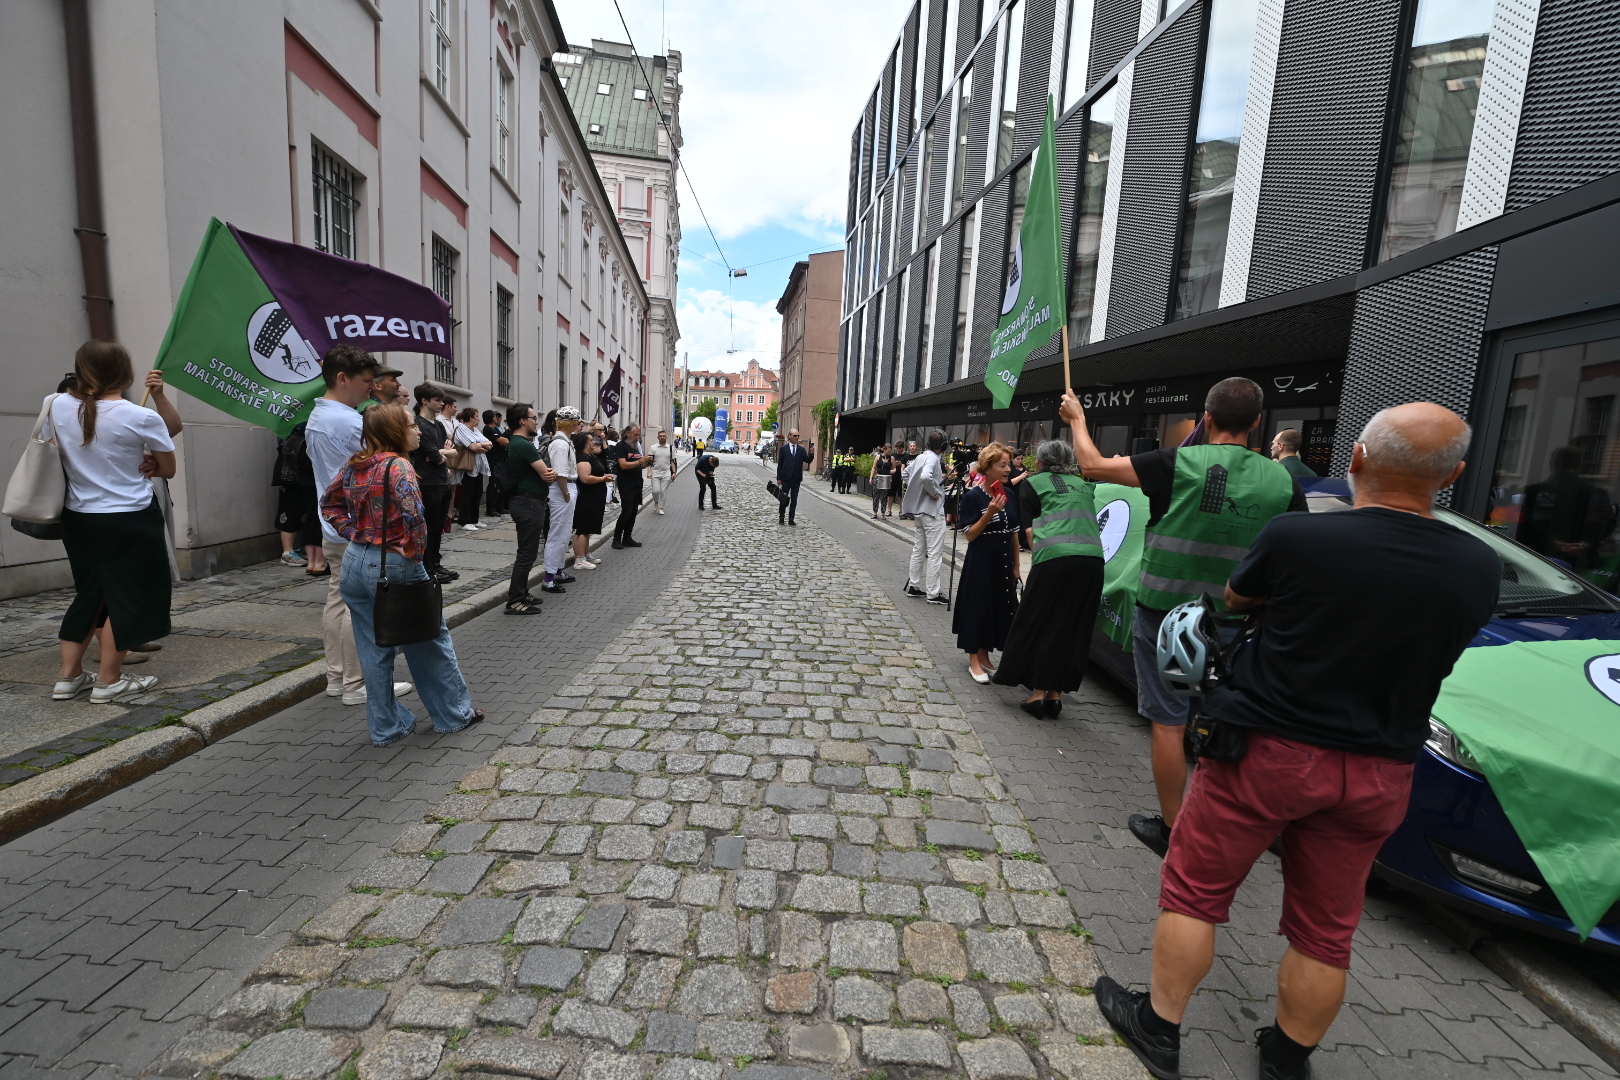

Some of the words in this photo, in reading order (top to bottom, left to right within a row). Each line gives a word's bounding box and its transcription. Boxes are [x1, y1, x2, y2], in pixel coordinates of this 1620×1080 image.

[324, 314, 446, 344] razem
[183, 361, 264, 409] MALTAŃSKIE
[1145, 385, 1167, 394] asian
[607, 389, 620, 404] ra
[1145, 393, 1189, 404] restaurant
